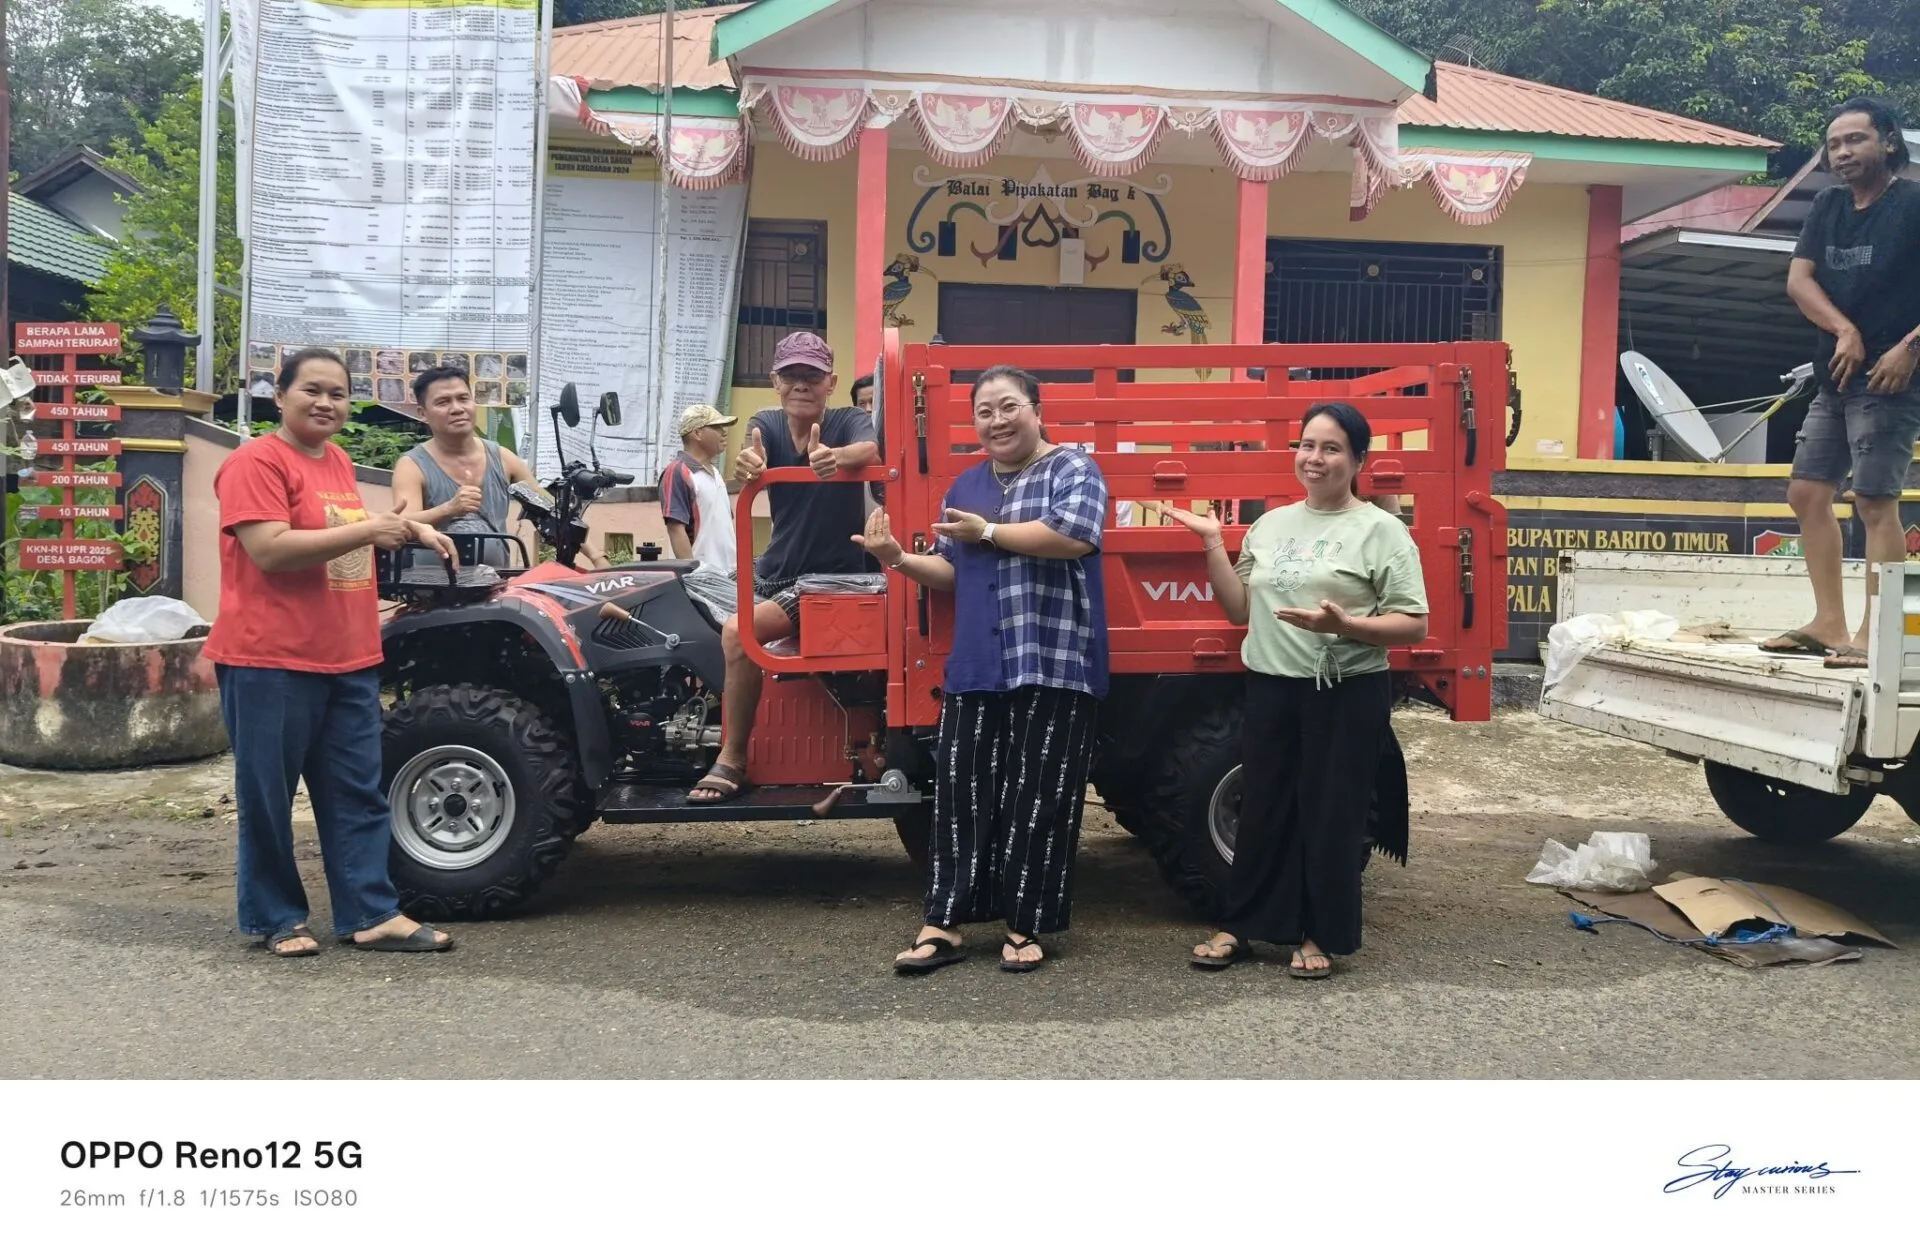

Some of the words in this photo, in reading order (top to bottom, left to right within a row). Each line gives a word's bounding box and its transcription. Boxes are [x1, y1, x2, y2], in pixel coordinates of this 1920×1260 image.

[947, 179, 990, 197] Balai
[1001, 178, 1078, 199] Pipakatan
[26, 327, 71, 336] BERAPA
[74, 327, 105, 336] LAMA
[18, 339, 64, 348] SAMPAH
[65, 338, 119, 347] TERURAI?
[37, 374, 70, 384] TIDAK
[74, 374, 121, 384] TERURAI
[50, 407, 69, 416] 450
[71, 407, 108, 417] TAHUN
[51, 442, 70, 452] 450
[72, 442, 109, 452] TAHUN
[52, 475, 70, 485] 200
[72, 475, 109, 485] TAHUN
[59, 508, 71, 516] 10
[73, 508, 110, 517] TAHUN
[1595, 529, 1667, 550] BARITO
[1672, 531, 1730, 552] TIMUR
[66, 545, 87, 554] UPR
[36, 555, 65, 564] DESA
[69, 555, 106, 564] BAGOK
[584, 575, 636, 594] VIAR
